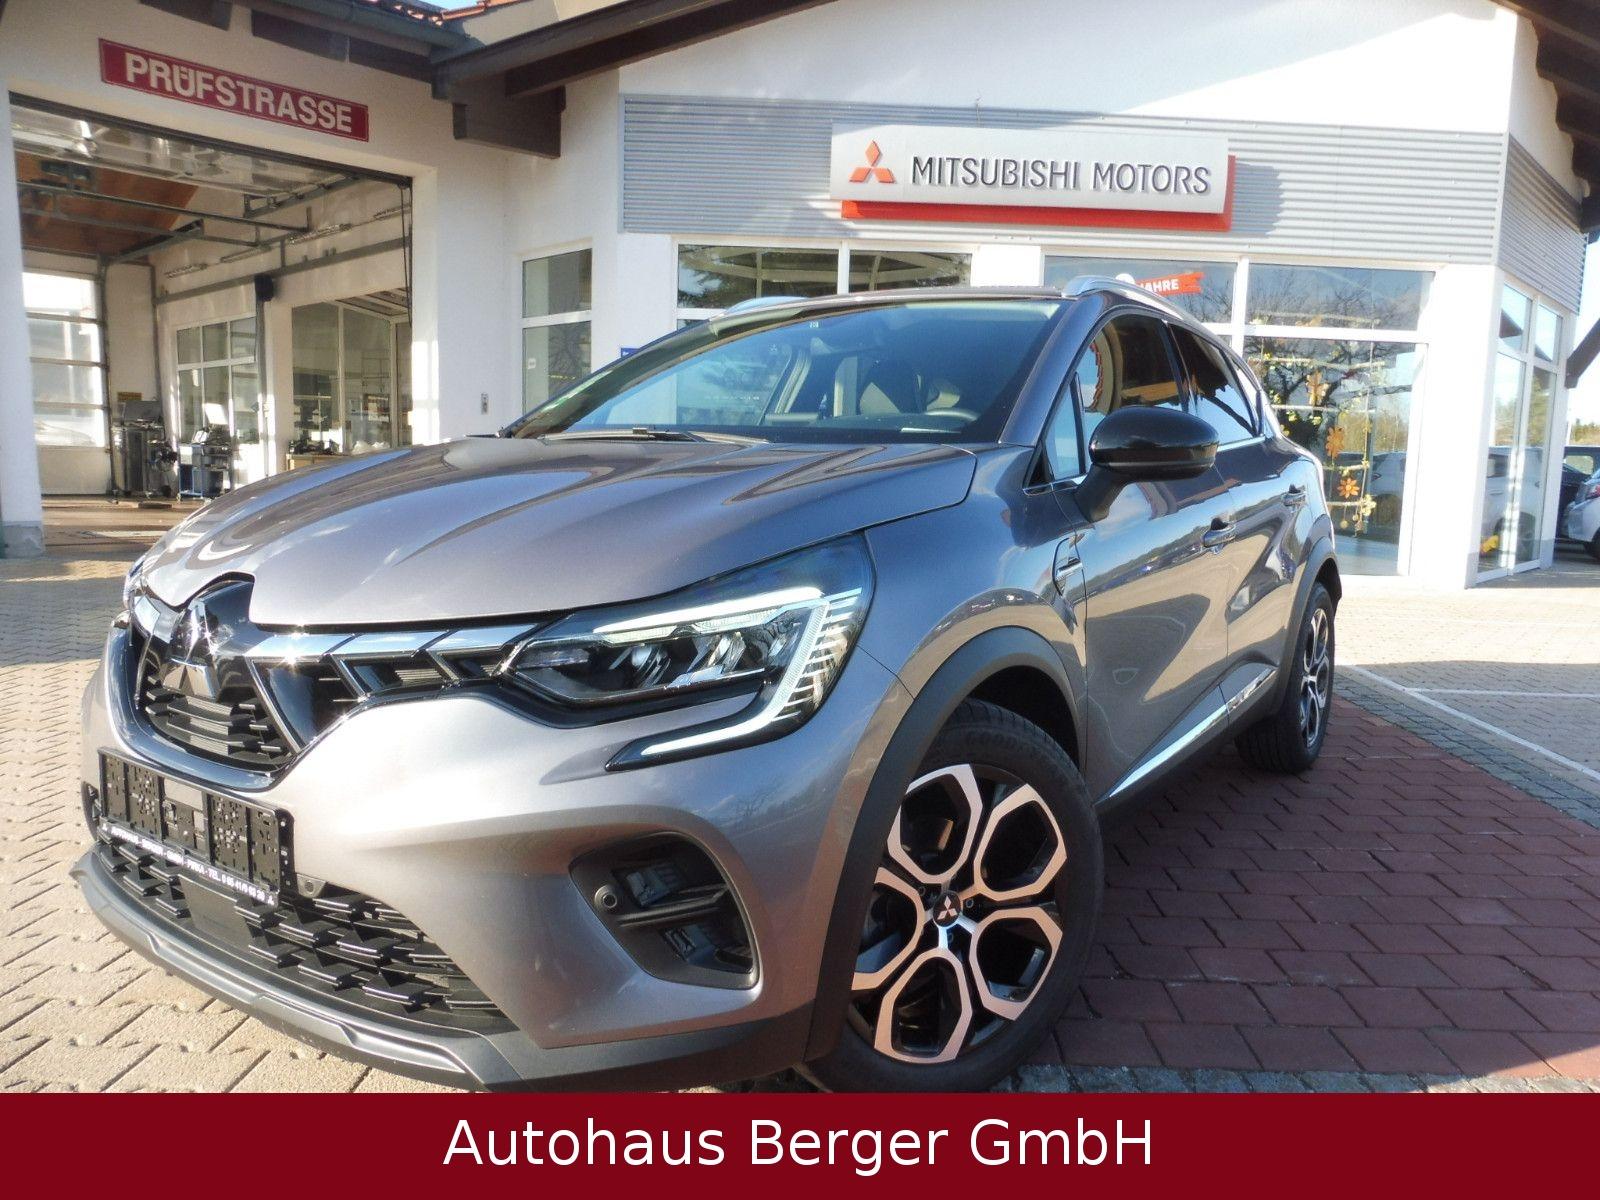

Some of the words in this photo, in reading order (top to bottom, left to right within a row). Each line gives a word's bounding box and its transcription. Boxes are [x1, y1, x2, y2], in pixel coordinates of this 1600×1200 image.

[124, 52, 352, 133] PRÜFSTRASSE
[912, 156, 1080, 190] MITSUBISHI
[1092, 162, 1210, 194] MOTORS
